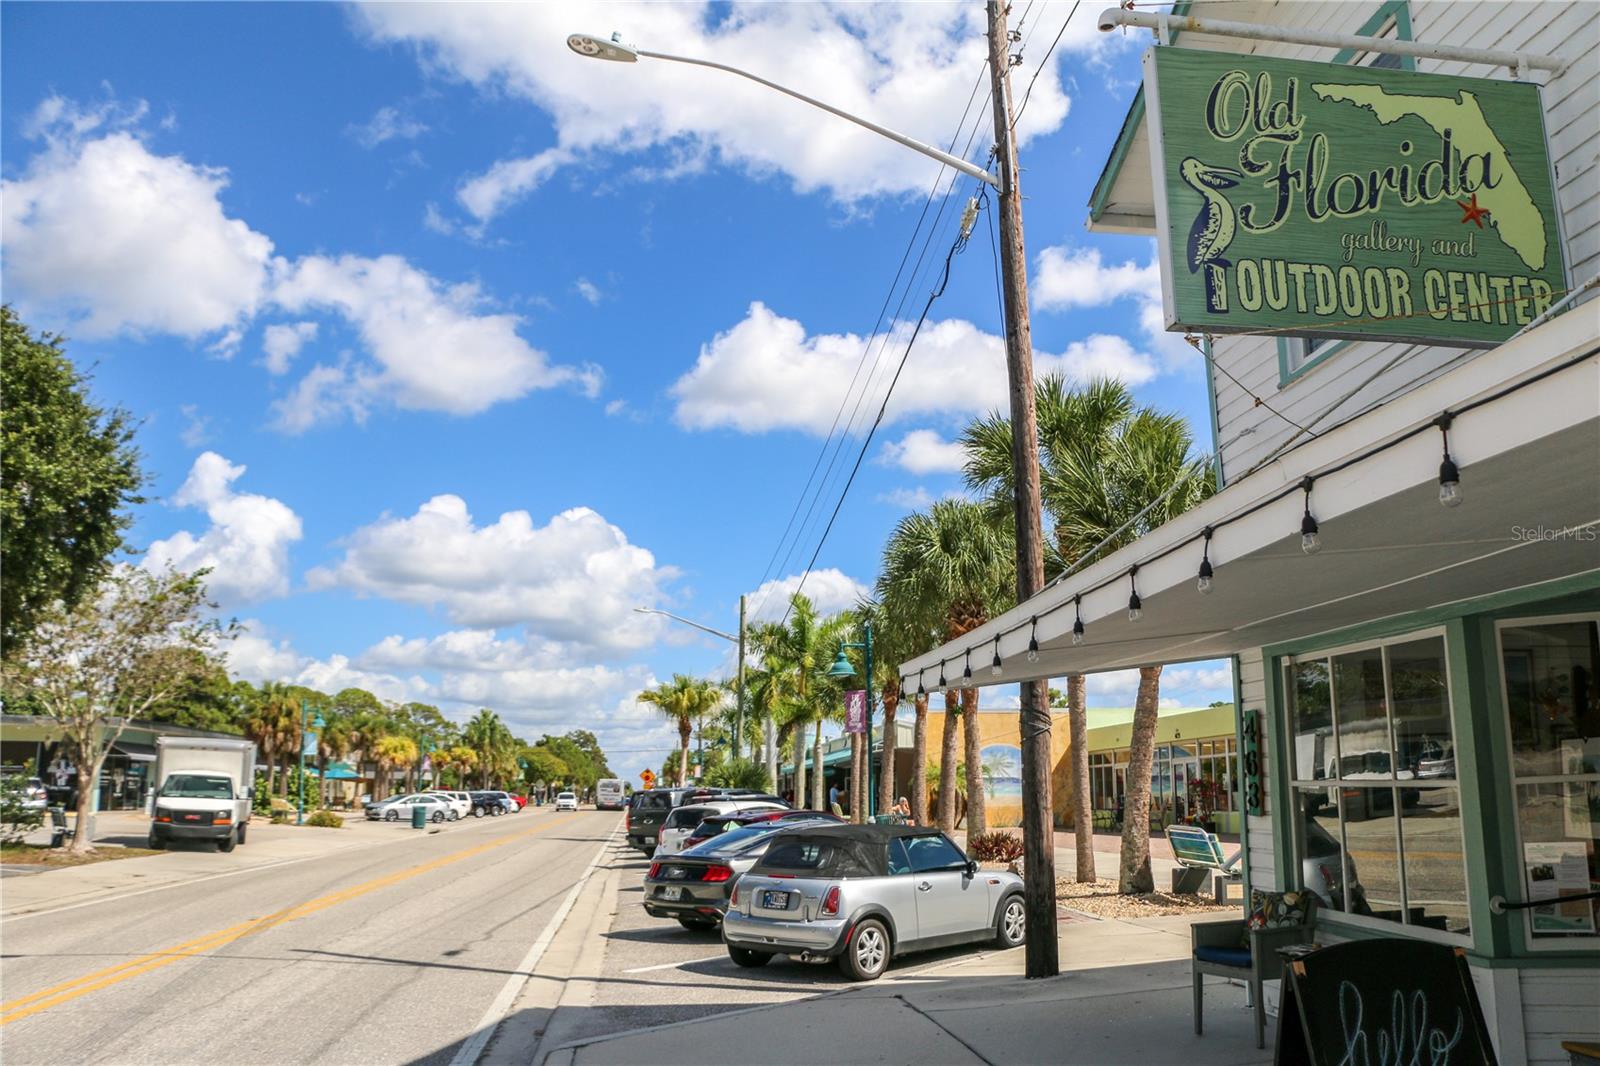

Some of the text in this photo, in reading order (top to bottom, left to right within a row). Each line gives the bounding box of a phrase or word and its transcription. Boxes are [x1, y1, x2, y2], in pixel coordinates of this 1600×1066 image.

[1205, 70, 1306, 142] Old
[1239, 128, 1503, 234] Florida
[1341, 219, 1477, 267] gallery and
[1236, 258, 1555, 326] OUTDOOR CENTER
[1338, 980, 1464, 1066] hello
